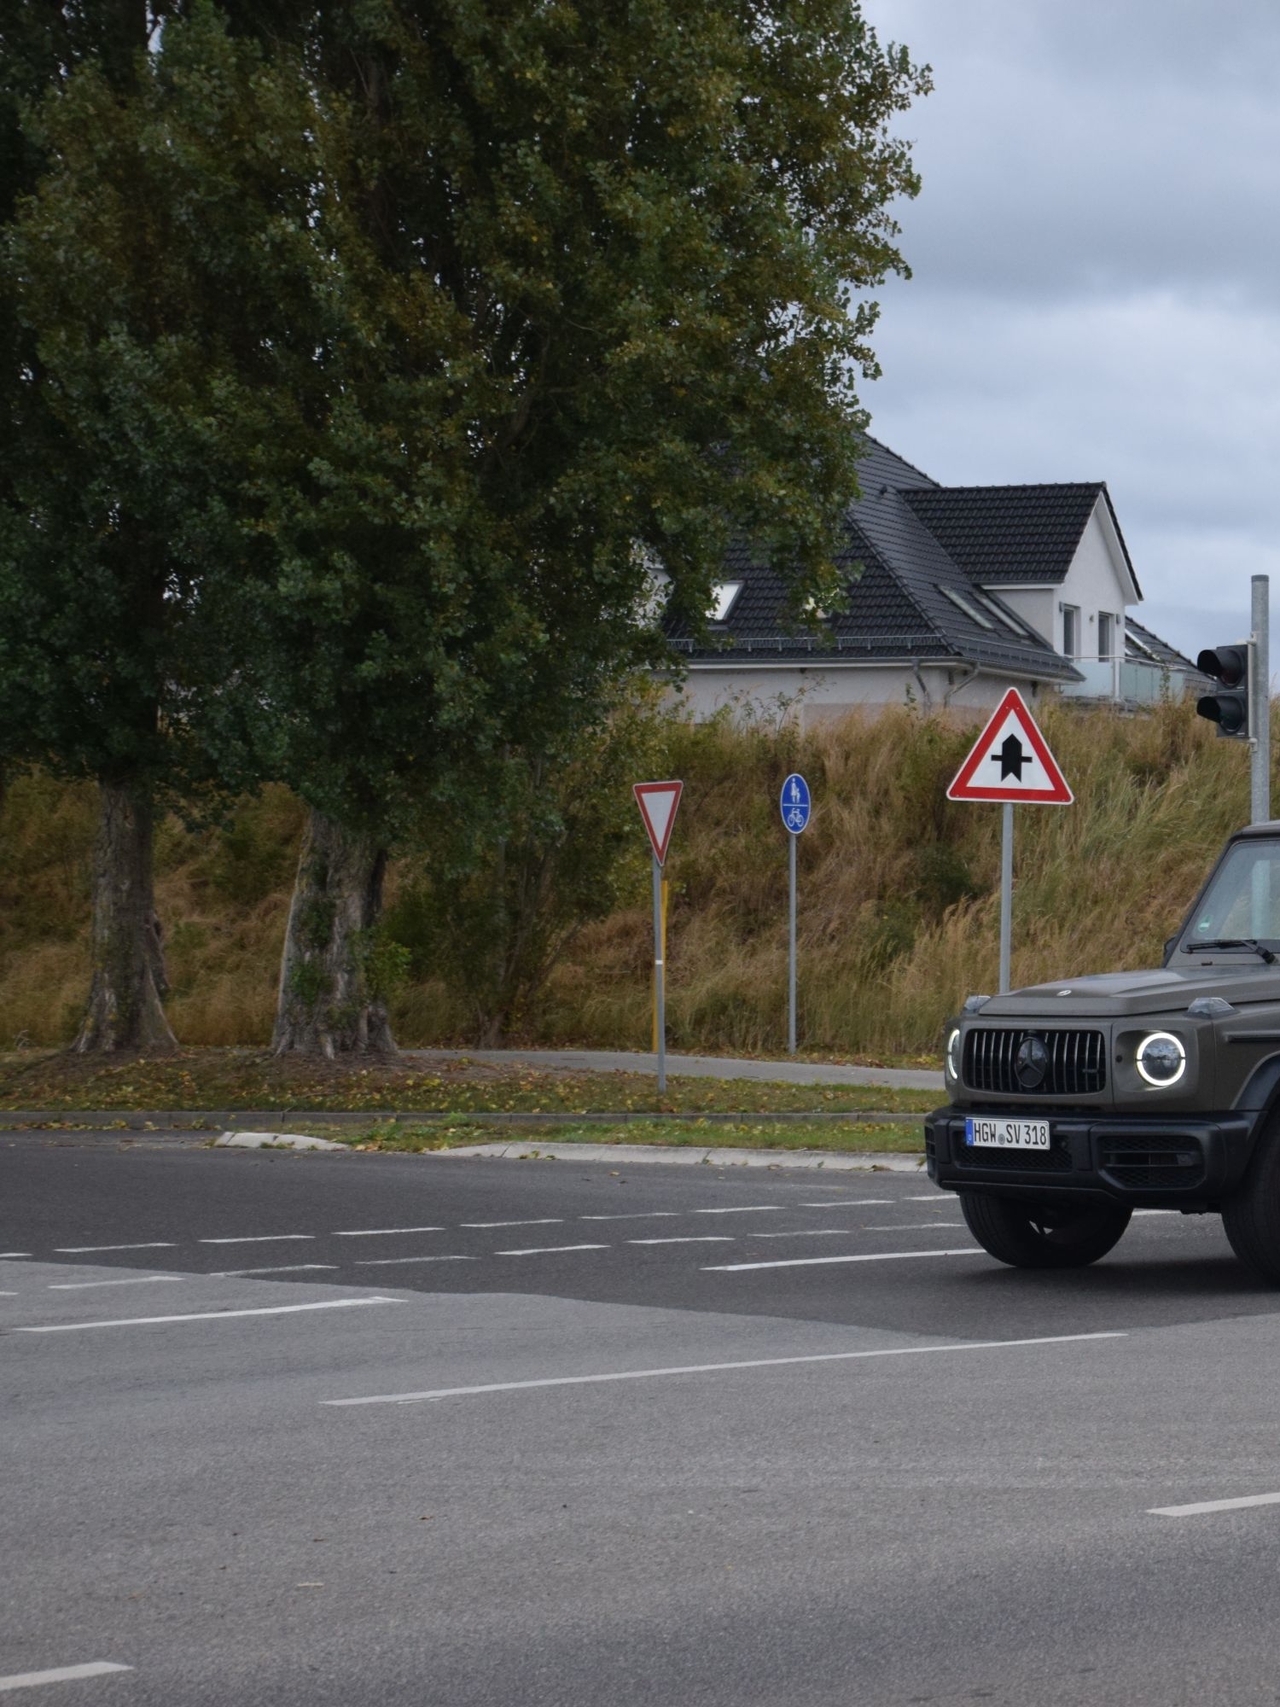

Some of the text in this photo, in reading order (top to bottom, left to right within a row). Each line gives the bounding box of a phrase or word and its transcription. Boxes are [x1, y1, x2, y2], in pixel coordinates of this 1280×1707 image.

[974, 1122, 1047, 1145] HGW SV 318
